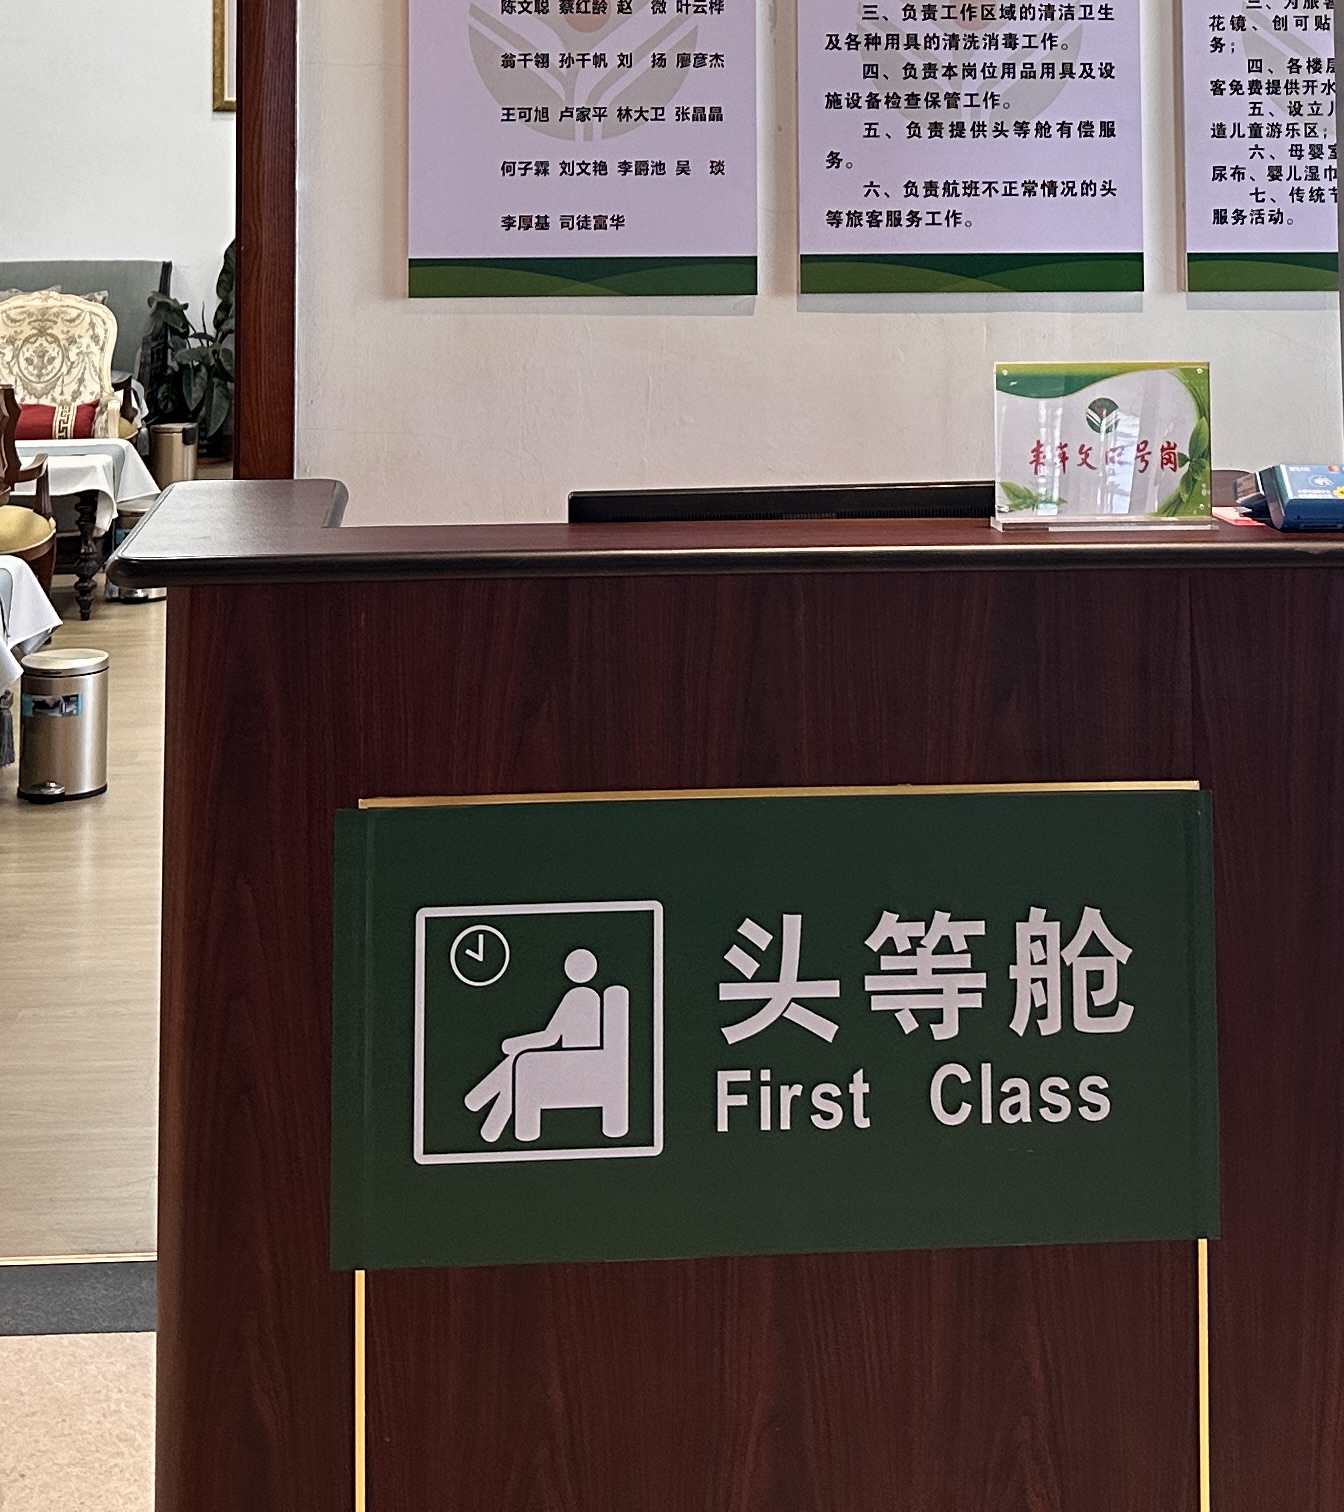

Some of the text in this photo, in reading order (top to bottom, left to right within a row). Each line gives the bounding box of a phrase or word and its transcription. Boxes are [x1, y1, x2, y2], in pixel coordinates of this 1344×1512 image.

[862, 4, 1115, 22] 三、负责工作区域的清洁卫生
[1209, 14, 1331, 32] 花镜、创可贴
[825, 32, 1069, 51] 及各种用具的清洗消毒工作。
[862, 62, 1116, 81] 四、负责本岗位用品用具及设
[825, 91, 1011, 110] 施设备检查保管工作。
[501, 106, 549, 122] 王可旭
[559, 106, 607, 122] 卢家平
[617, 106, 666, 122] 林大卫
[862, 121, 1117, 139] 五、负责提供头等舱有偿服
[825, 150, 854, 170] 务。
[863, 180, 1117, 199] 六、负责航班不正常情况的头
[826, 210, 973, 229] 等旅客服务工作。
[1212, 209, 1294, 226] 服务活动。
[718, 905, 1135, 1044] 头等舱
[716, 1062, 1112, 1132] First Class
